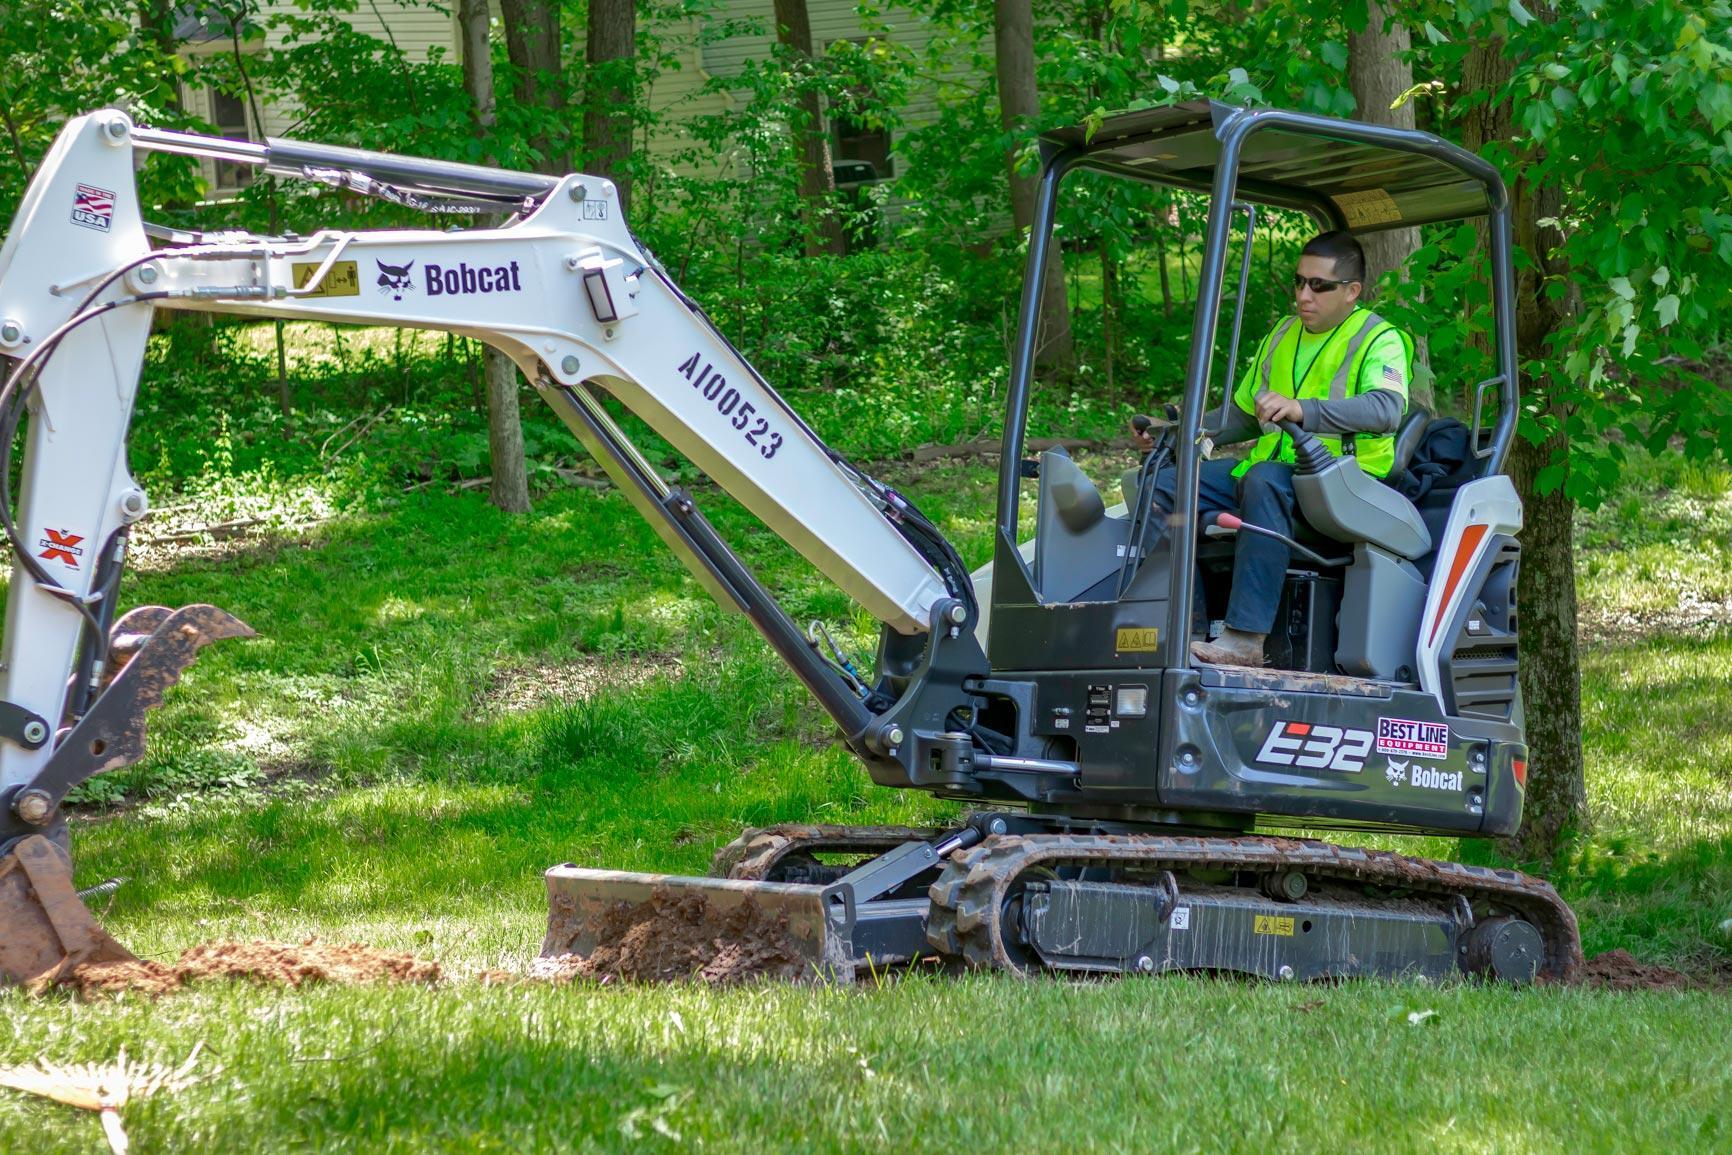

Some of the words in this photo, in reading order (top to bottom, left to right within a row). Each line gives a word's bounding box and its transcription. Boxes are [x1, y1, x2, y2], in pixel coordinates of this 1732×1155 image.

[73, 209, 108, 228] USA
[424, 261, 521, 296] Bobcat
[1379, 718, 1415, 741] BEST
[1417, 722, 1447, 744] LINE
[1255, 721, 1375, 773] E32
[1379, 739, 1445, 753] EQUIPMENT
[1411, 765, 1463, 791] Bobcat
